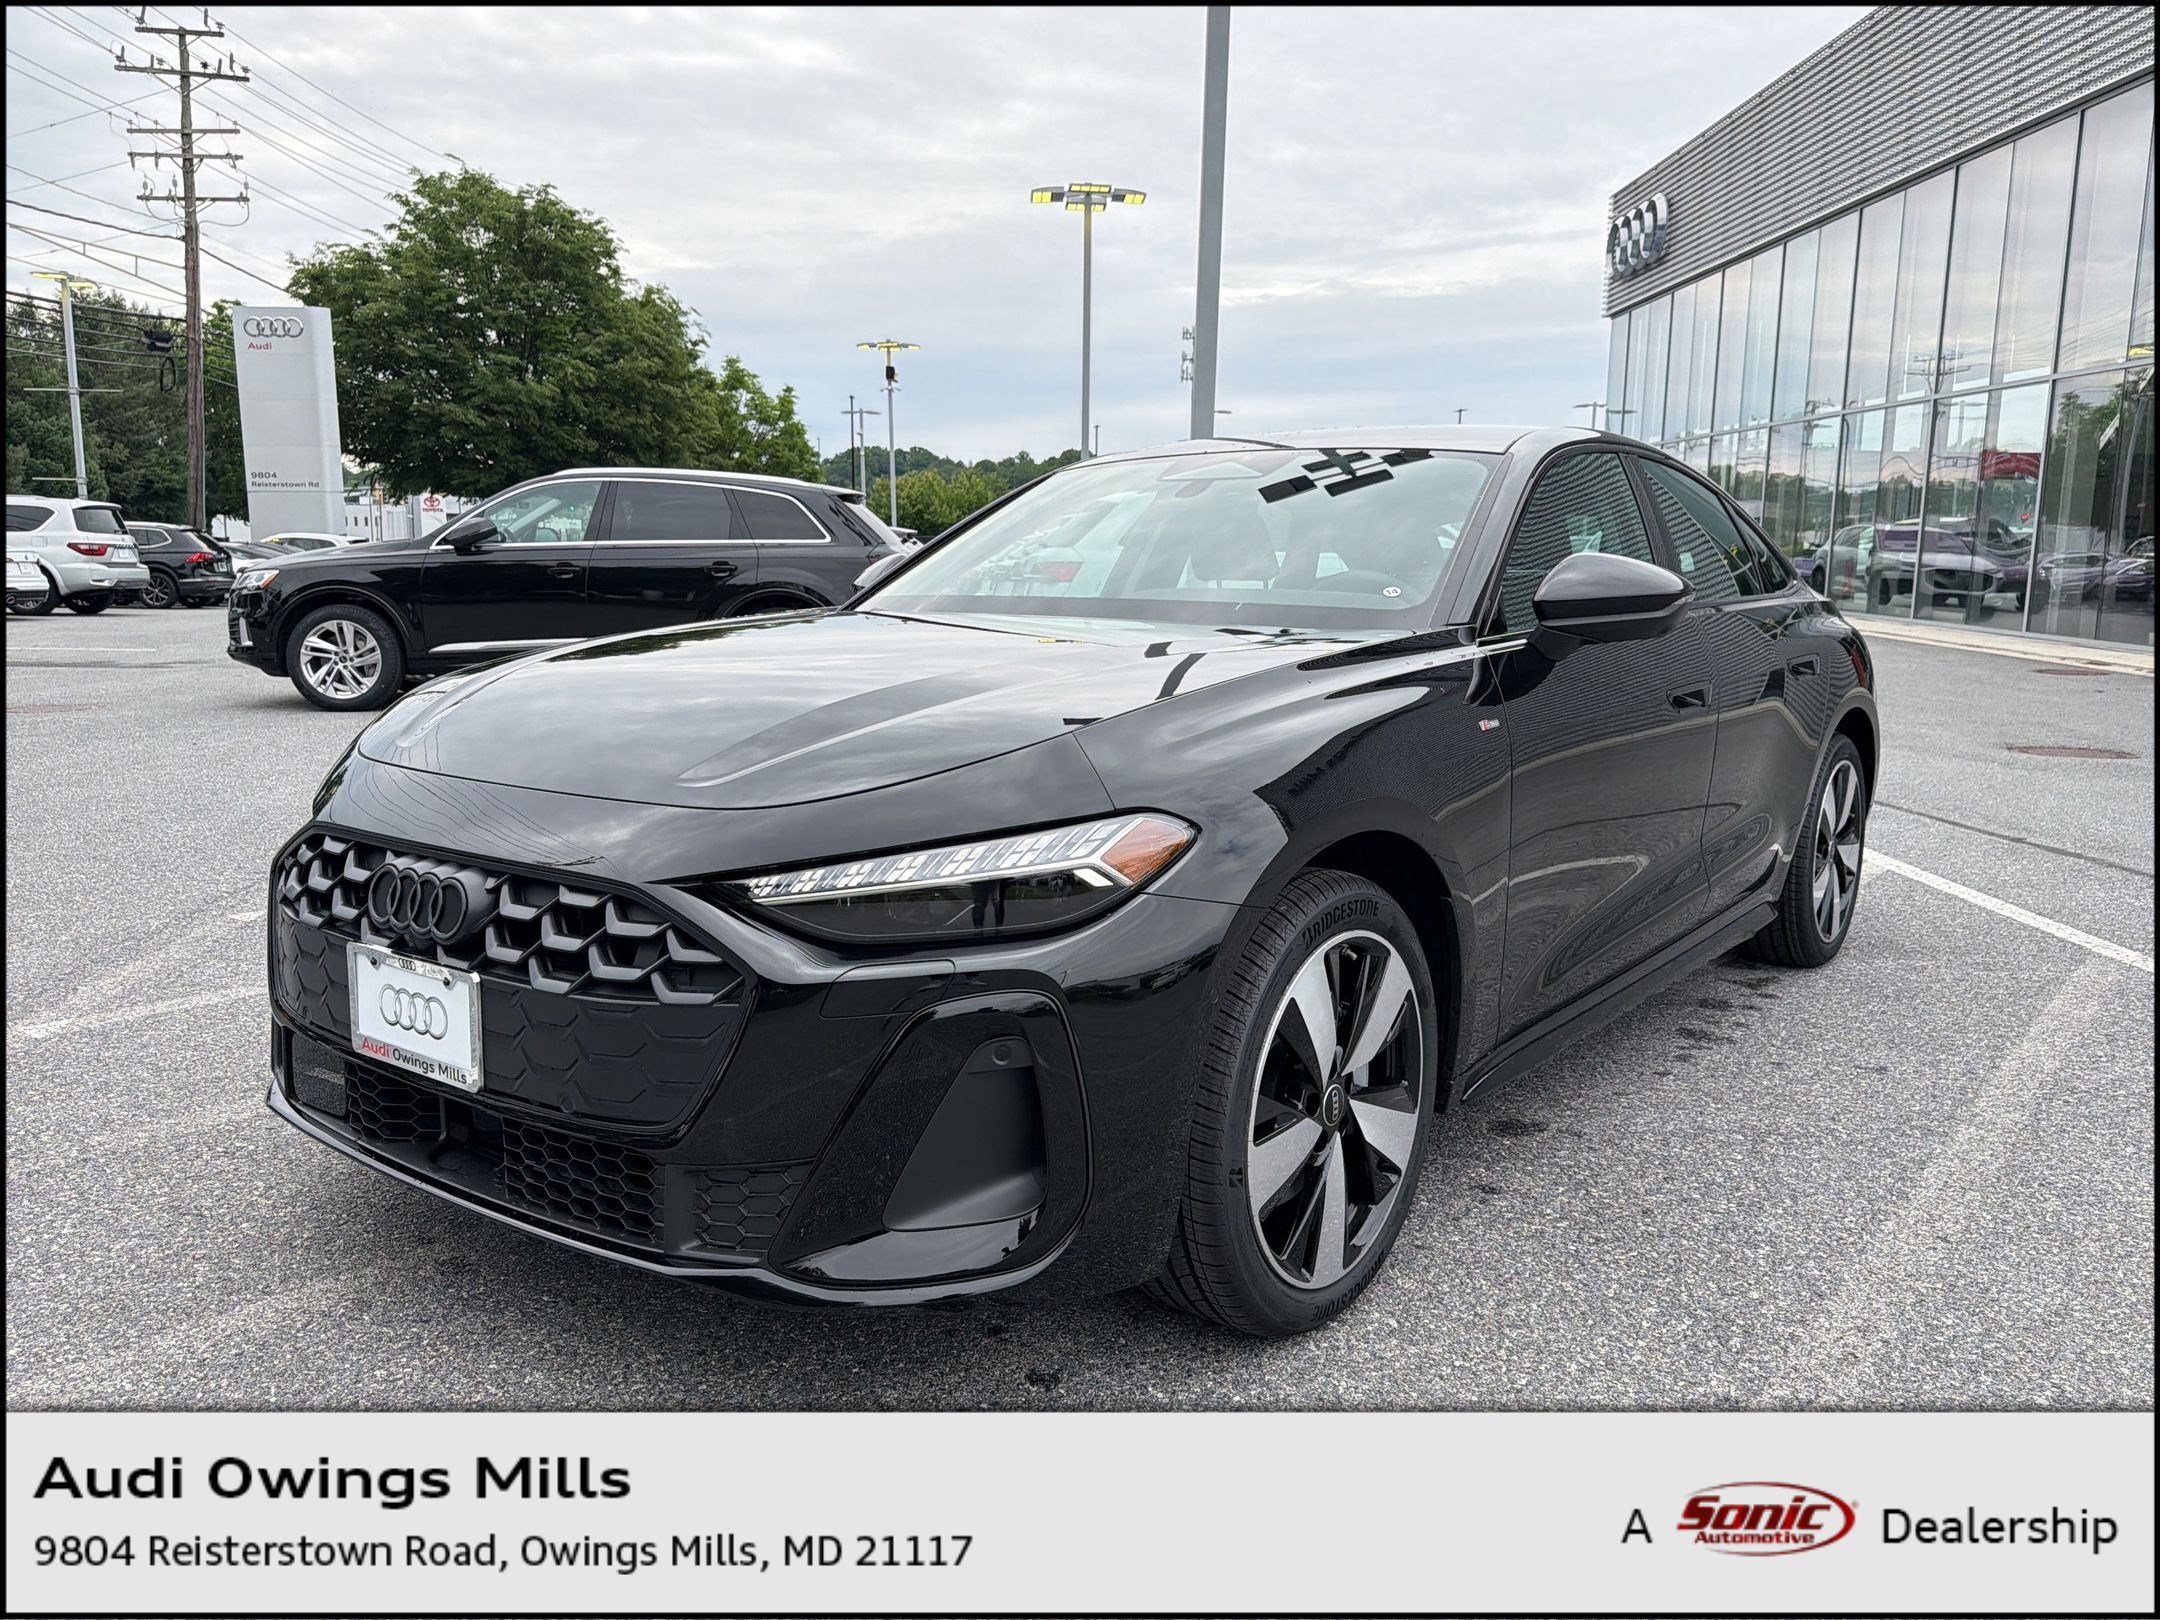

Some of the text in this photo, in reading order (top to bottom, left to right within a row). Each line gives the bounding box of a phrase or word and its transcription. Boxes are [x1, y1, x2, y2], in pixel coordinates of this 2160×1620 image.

[248, 342, 272, 350] Audi
[251, 471, 277, 479] 9804
[251, 481, 320, 489] Reisterstown Rd
[1302, 899, 1380, 951] BRIDGESTONE
[362, 1037, 468, 1085] Audi Owings Mills
